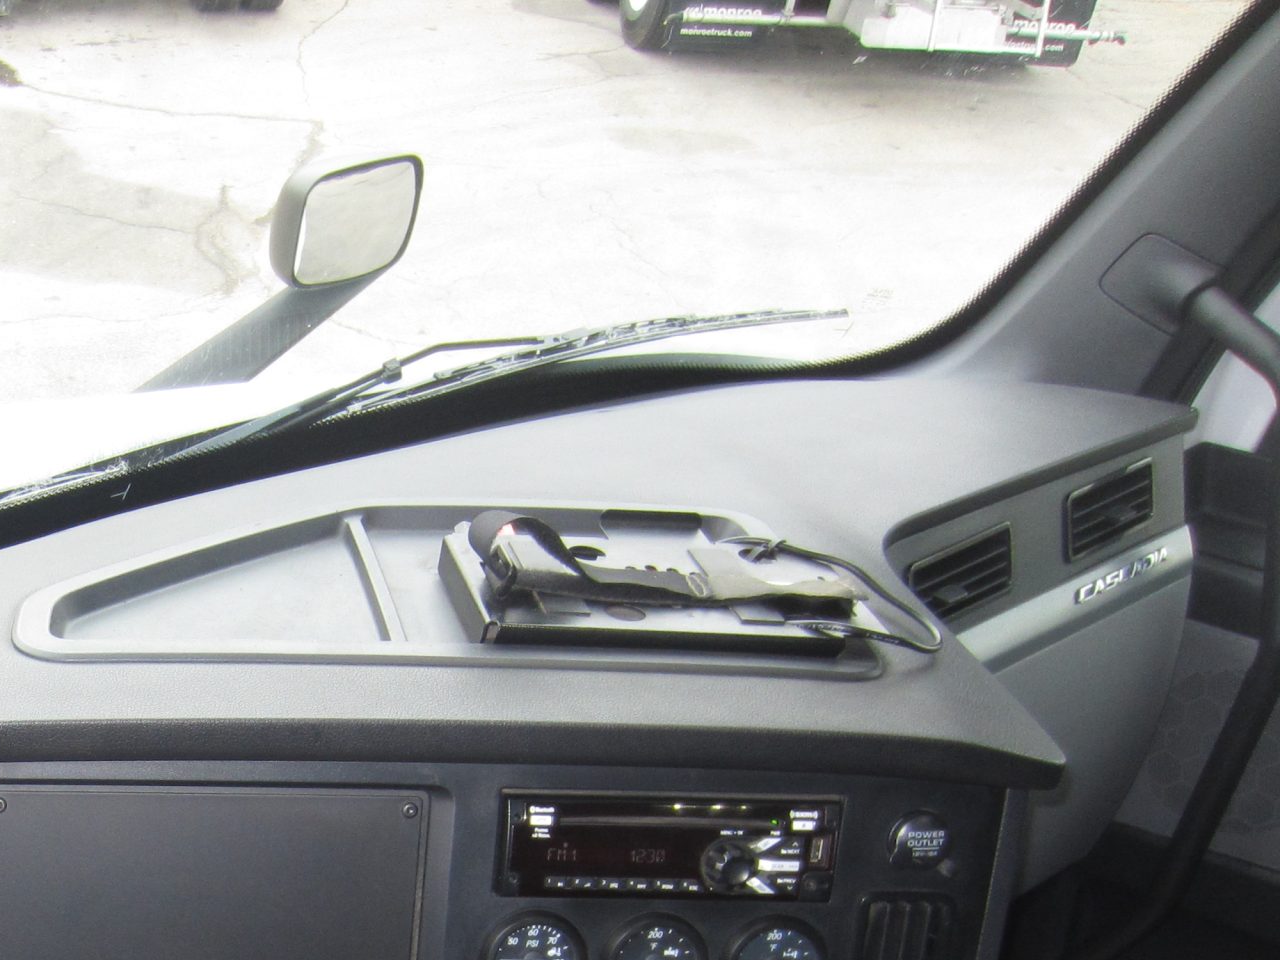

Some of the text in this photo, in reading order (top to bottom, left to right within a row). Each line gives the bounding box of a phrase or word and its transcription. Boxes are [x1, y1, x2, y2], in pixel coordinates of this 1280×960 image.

[1012, 19, 1076, 32] moroe
[908, 830, 945, 839] POWER
[907, 839, 944, 847] OUTLET
[527, 928, 539, 937] 60
[647, 930, 664, 940] 200
[767, 932, 783, 942] 200
[525, 939, 539, 948] PSI
[546, 936, 558, 945] 70
